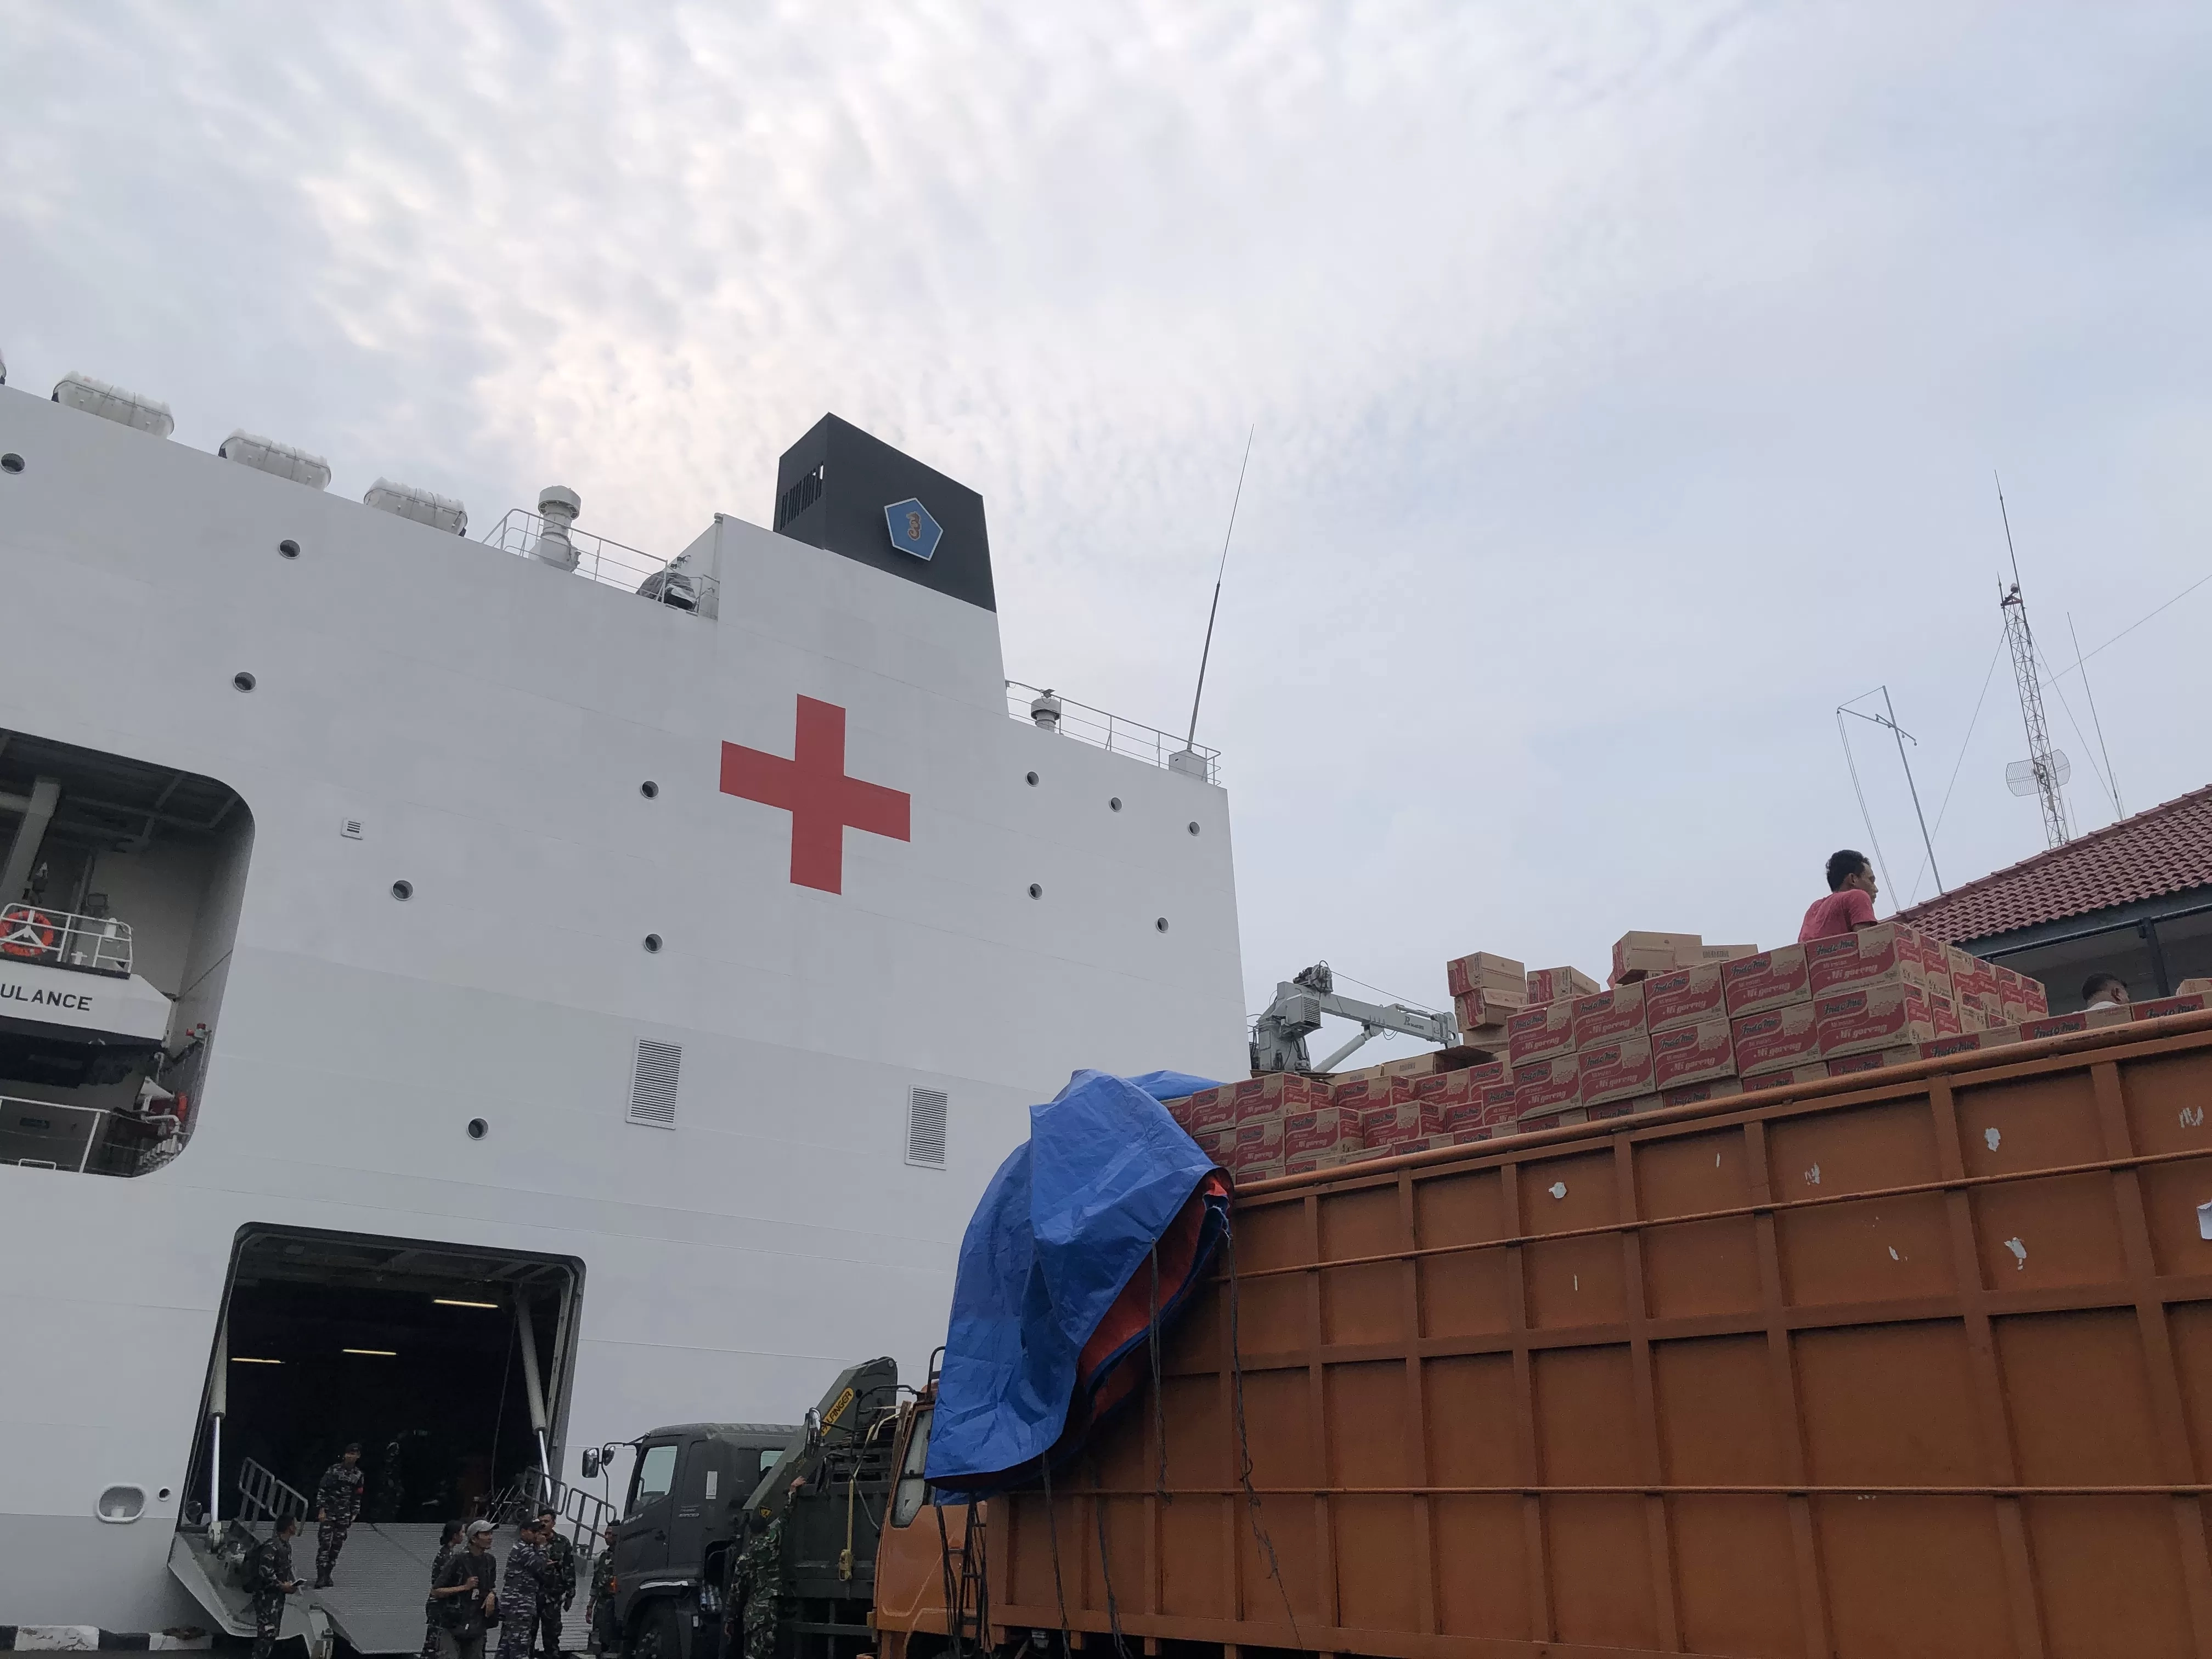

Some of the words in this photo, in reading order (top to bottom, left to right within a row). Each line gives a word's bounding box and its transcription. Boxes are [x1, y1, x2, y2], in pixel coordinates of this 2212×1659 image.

[1653, 977, 1686, 993] Indomie
[1581, 998, 1611, 1013] Indomie
[1514, 1015, 1544, 1029] Indomie
[1587, 1051, 1617, 1066] Indomie
[1520, 1068, 1548, 1082] Indomie
